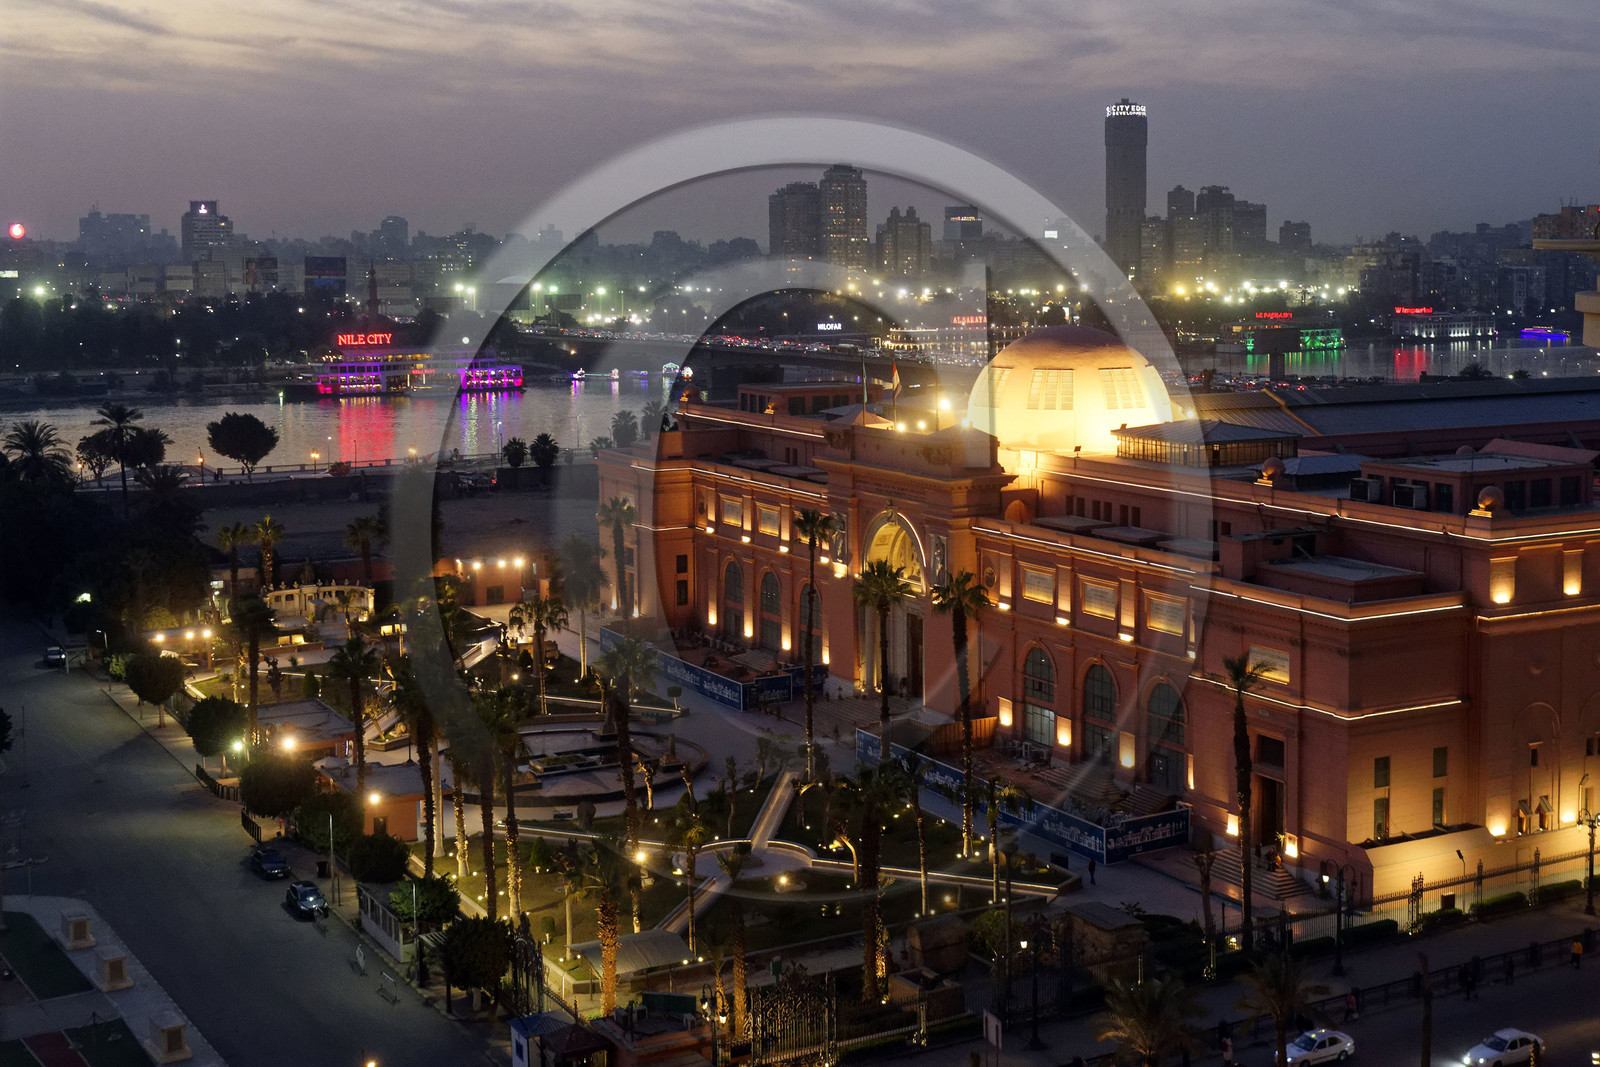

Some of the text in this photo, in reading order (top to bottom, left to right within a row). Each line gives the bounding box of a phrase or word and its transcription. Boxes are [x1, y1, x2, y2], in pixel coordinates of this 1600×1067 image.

[1112, 104, 1130, 112] CITY
[817, 322, 842, 331] NILOFAR
[337, 332, 393, 346] NILE CITY
